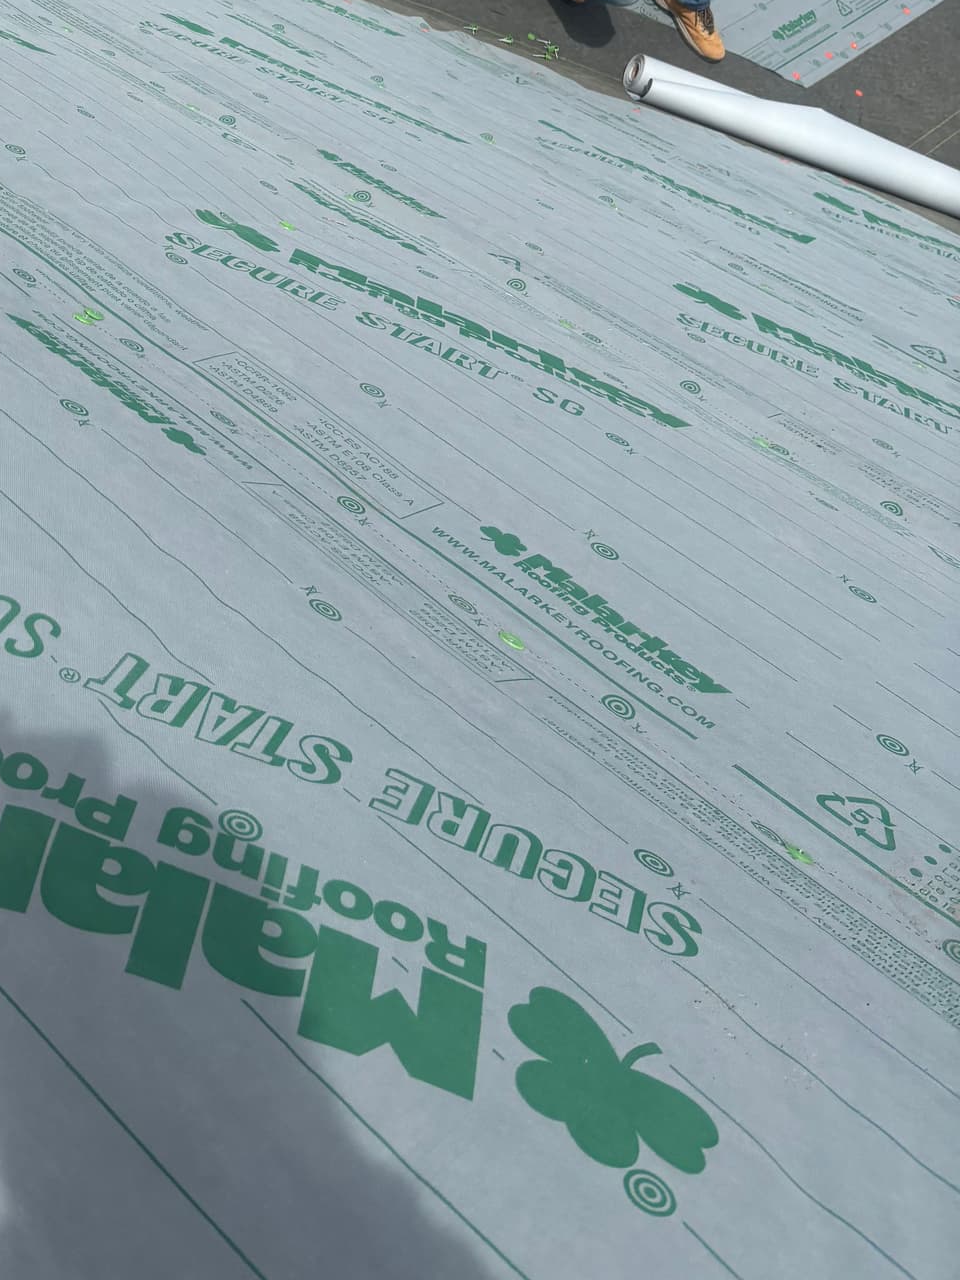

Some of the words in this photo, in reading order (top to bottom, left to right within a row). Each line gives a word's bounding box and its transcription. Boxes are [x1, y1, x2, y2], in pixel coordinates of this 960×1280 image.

[165, 232, 346, 312] SECURE
[532, 386, 586, 417] SG
[212, 366, 244, 389] ASTM
[223, 362, 257, 387] ASTM
[289, 248, 693, 428] Malarkey
[676, 313, 820, 380] SECURE
[833, 376, 953, 435] START
[297, 426, 331, 455] ASTM
[308, 422, 343, 450] ASTM
[372, 472, 403, 498] Class
[321, 420, 362, 450] ICC-ES
[432, 526, 716, 730] WWW.MALARKEYROOFING.COM
[513, 554, 733, 694] Malarkey
[514, 560, 591, 617] Roofing
[156, 806, 488, 990] Roofing
[368, 767, 703, 957] SECURE
